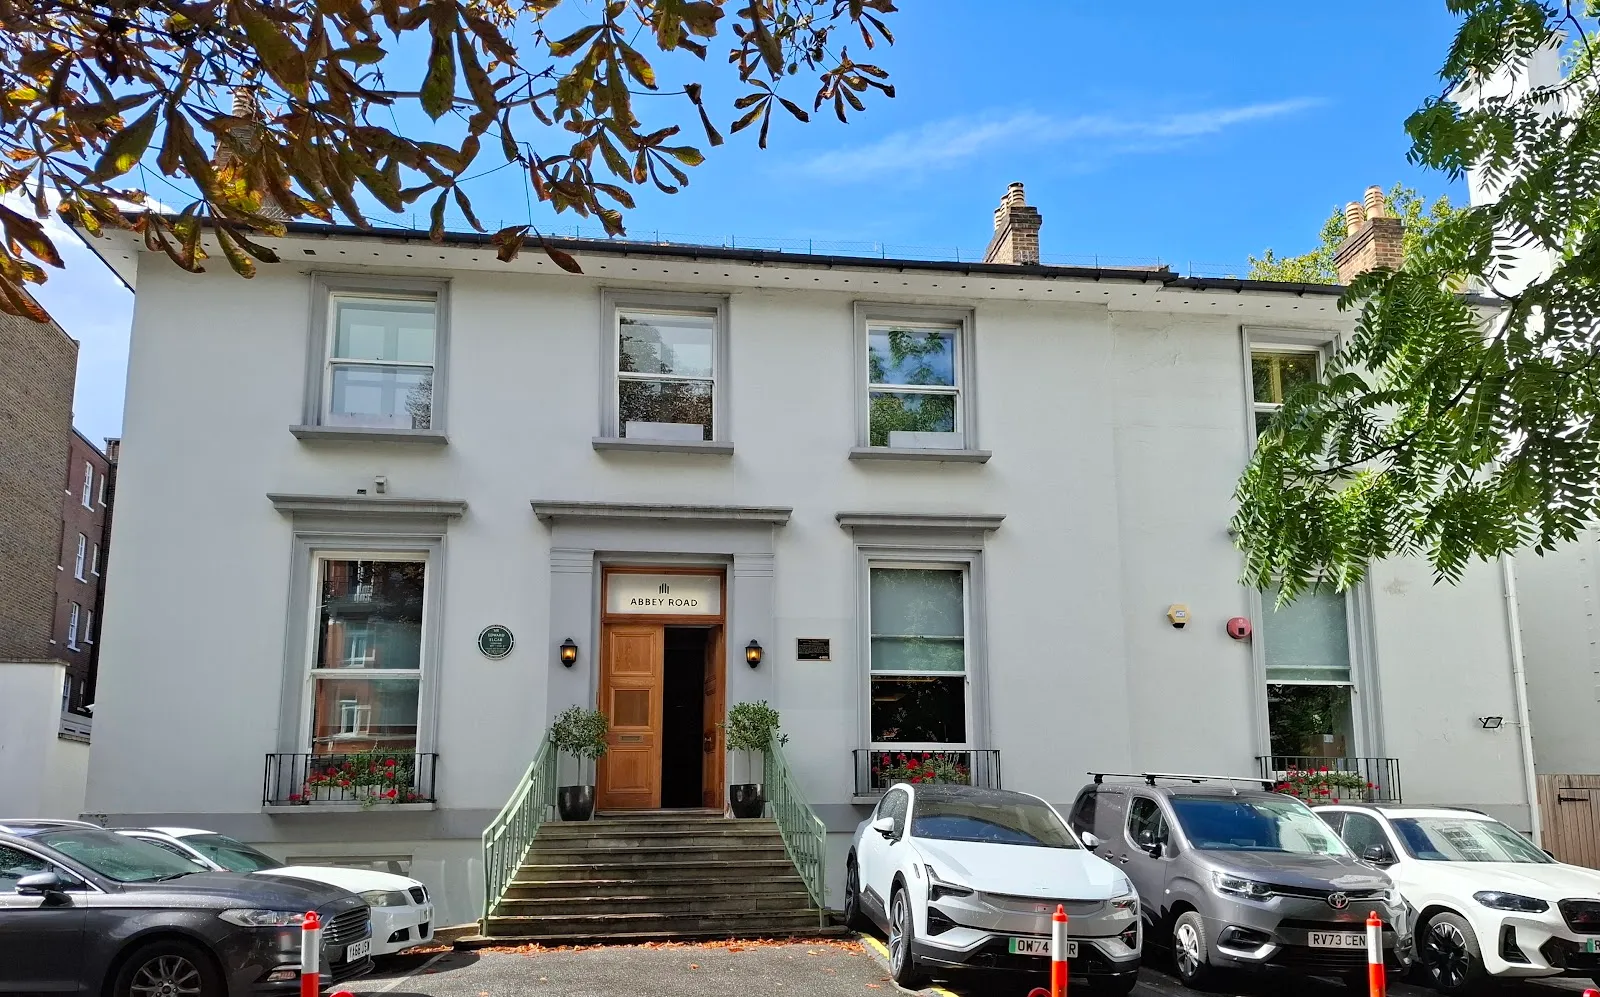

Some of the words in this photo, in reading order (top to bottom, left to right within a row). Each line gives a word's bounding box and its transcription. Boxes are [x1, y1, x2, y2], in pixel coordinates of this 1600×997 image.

[630, 598, 664, 606] ABBEY
[668, 599, 698, 607] ROAD
[1313, 934, 1342, 945] RV73
[1345, 935, 1366, 946] CEN
[1018, 940, 1049, 953] OW74
